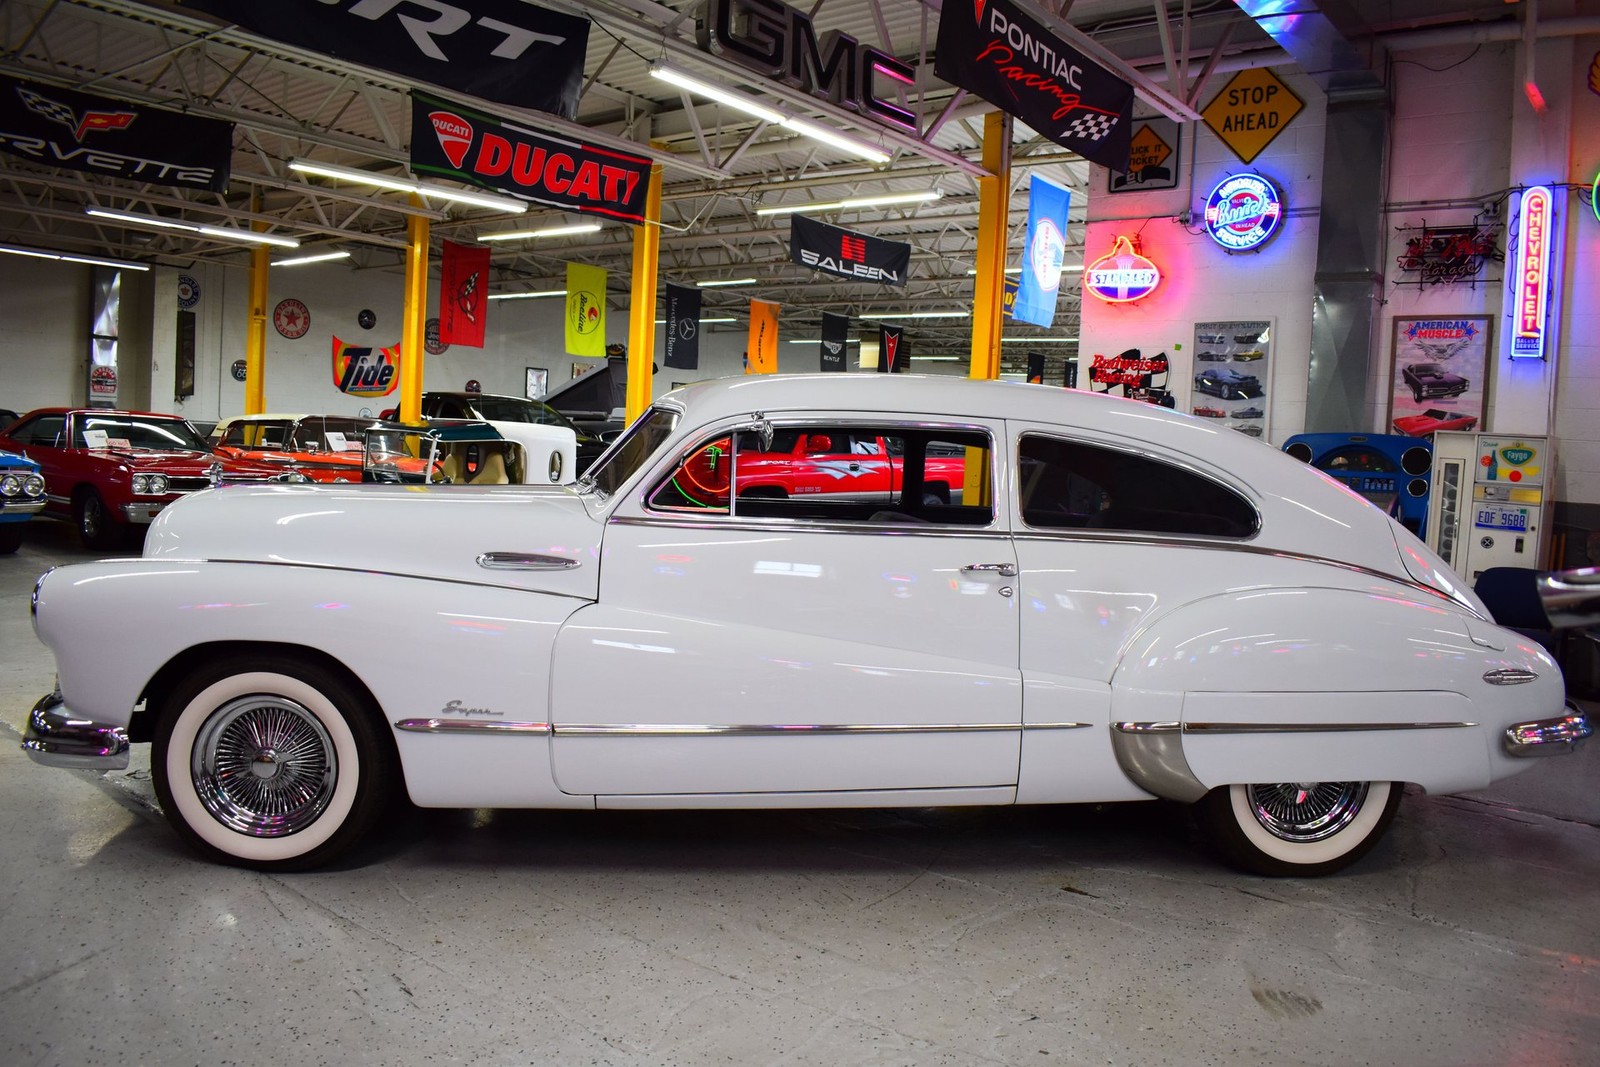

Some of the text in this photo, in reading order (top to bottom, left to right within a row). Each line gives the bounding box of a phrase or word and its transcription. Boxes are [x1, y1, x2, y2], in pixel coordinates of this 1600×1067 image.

[318, 0, 567, 62] RT
[991, 8, 1083, 91] PONTIAC
[697, 0, 916, 132] GMC
[976, 40, 1120, 120] Racing
[1228, 86, 1278, 106] STOP
[433, 118, 470, 137] DUCATI
[1223, 112, 1279, 132] AHEAD
[0, 133, 214, 183] RVETTE
[1131, 144, 1162, 155] LICK IT
[474, 133, 640, 206] DUCATI
[1216, 226, 1266, 247] SERVICE
[801, 249, 898, 281] SALEEN
[1526, 199, 1543, 330] CHEVROLET
[578, 293, 588, 332] Beeline
[668, 296, 679, 357] Mercedes-Benz
[1229, 321, 1270, 329] EVOLUTION
[1414, 321, 1469, 330] AMERICAN
[1417, 330, 1464, 339] MUSCLE
[340, 348, 394, 393] Tide
[1092, 354, 1168, 372] Budweiser
[1093, 371, 1146, 388] Racing
[1507, 451, 1528, 460] Faygo
[1478, 511, 1526, 527] EDF 9688
[442, 700, 504, 716] Super
